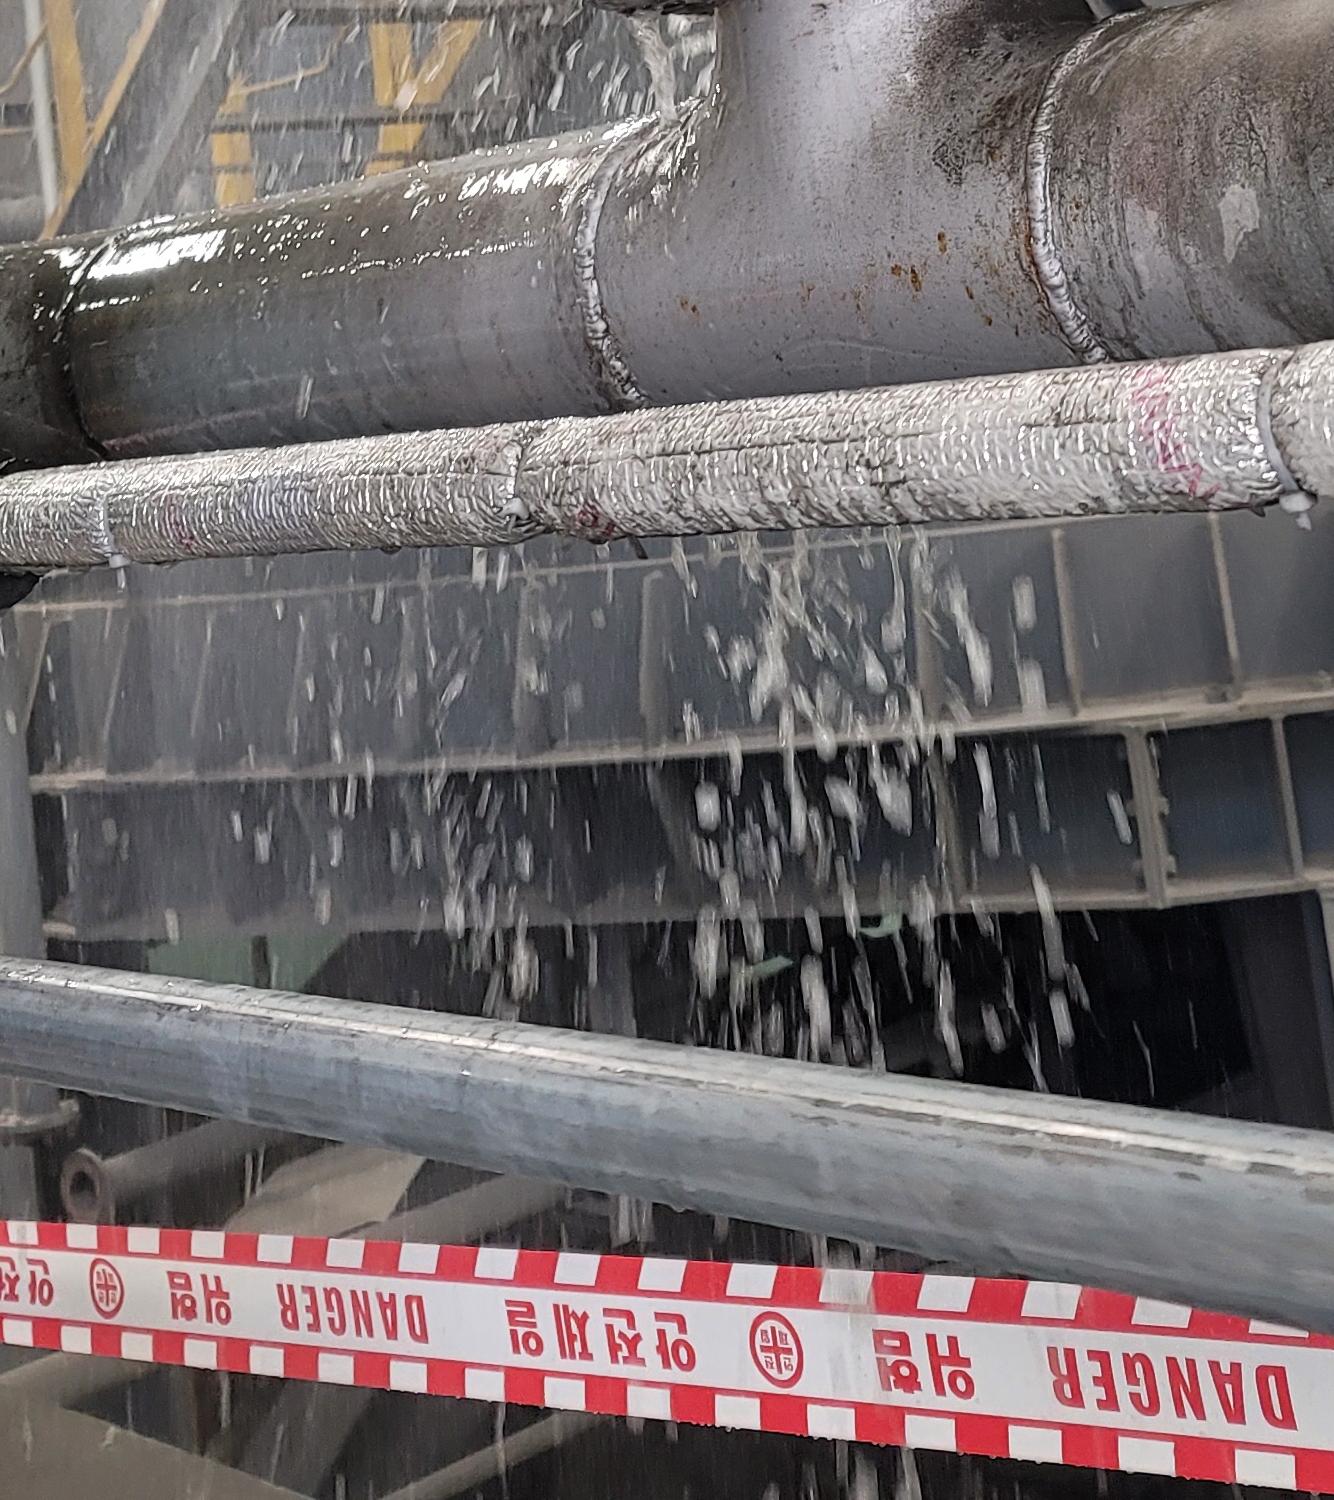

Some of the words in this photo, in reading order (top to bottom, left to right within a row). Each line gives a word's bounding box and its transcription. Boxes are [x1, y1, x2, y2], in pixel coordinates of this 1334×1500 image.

[166, 1270, 232, 1325] 위험
[276, 1283, 429, 1344] DANGER
[504, 1299, 696, 1373] 안전제일
[873, 1329, 975, 1399] 위험
[1047, 1346, 1298, 1431] DANGER
